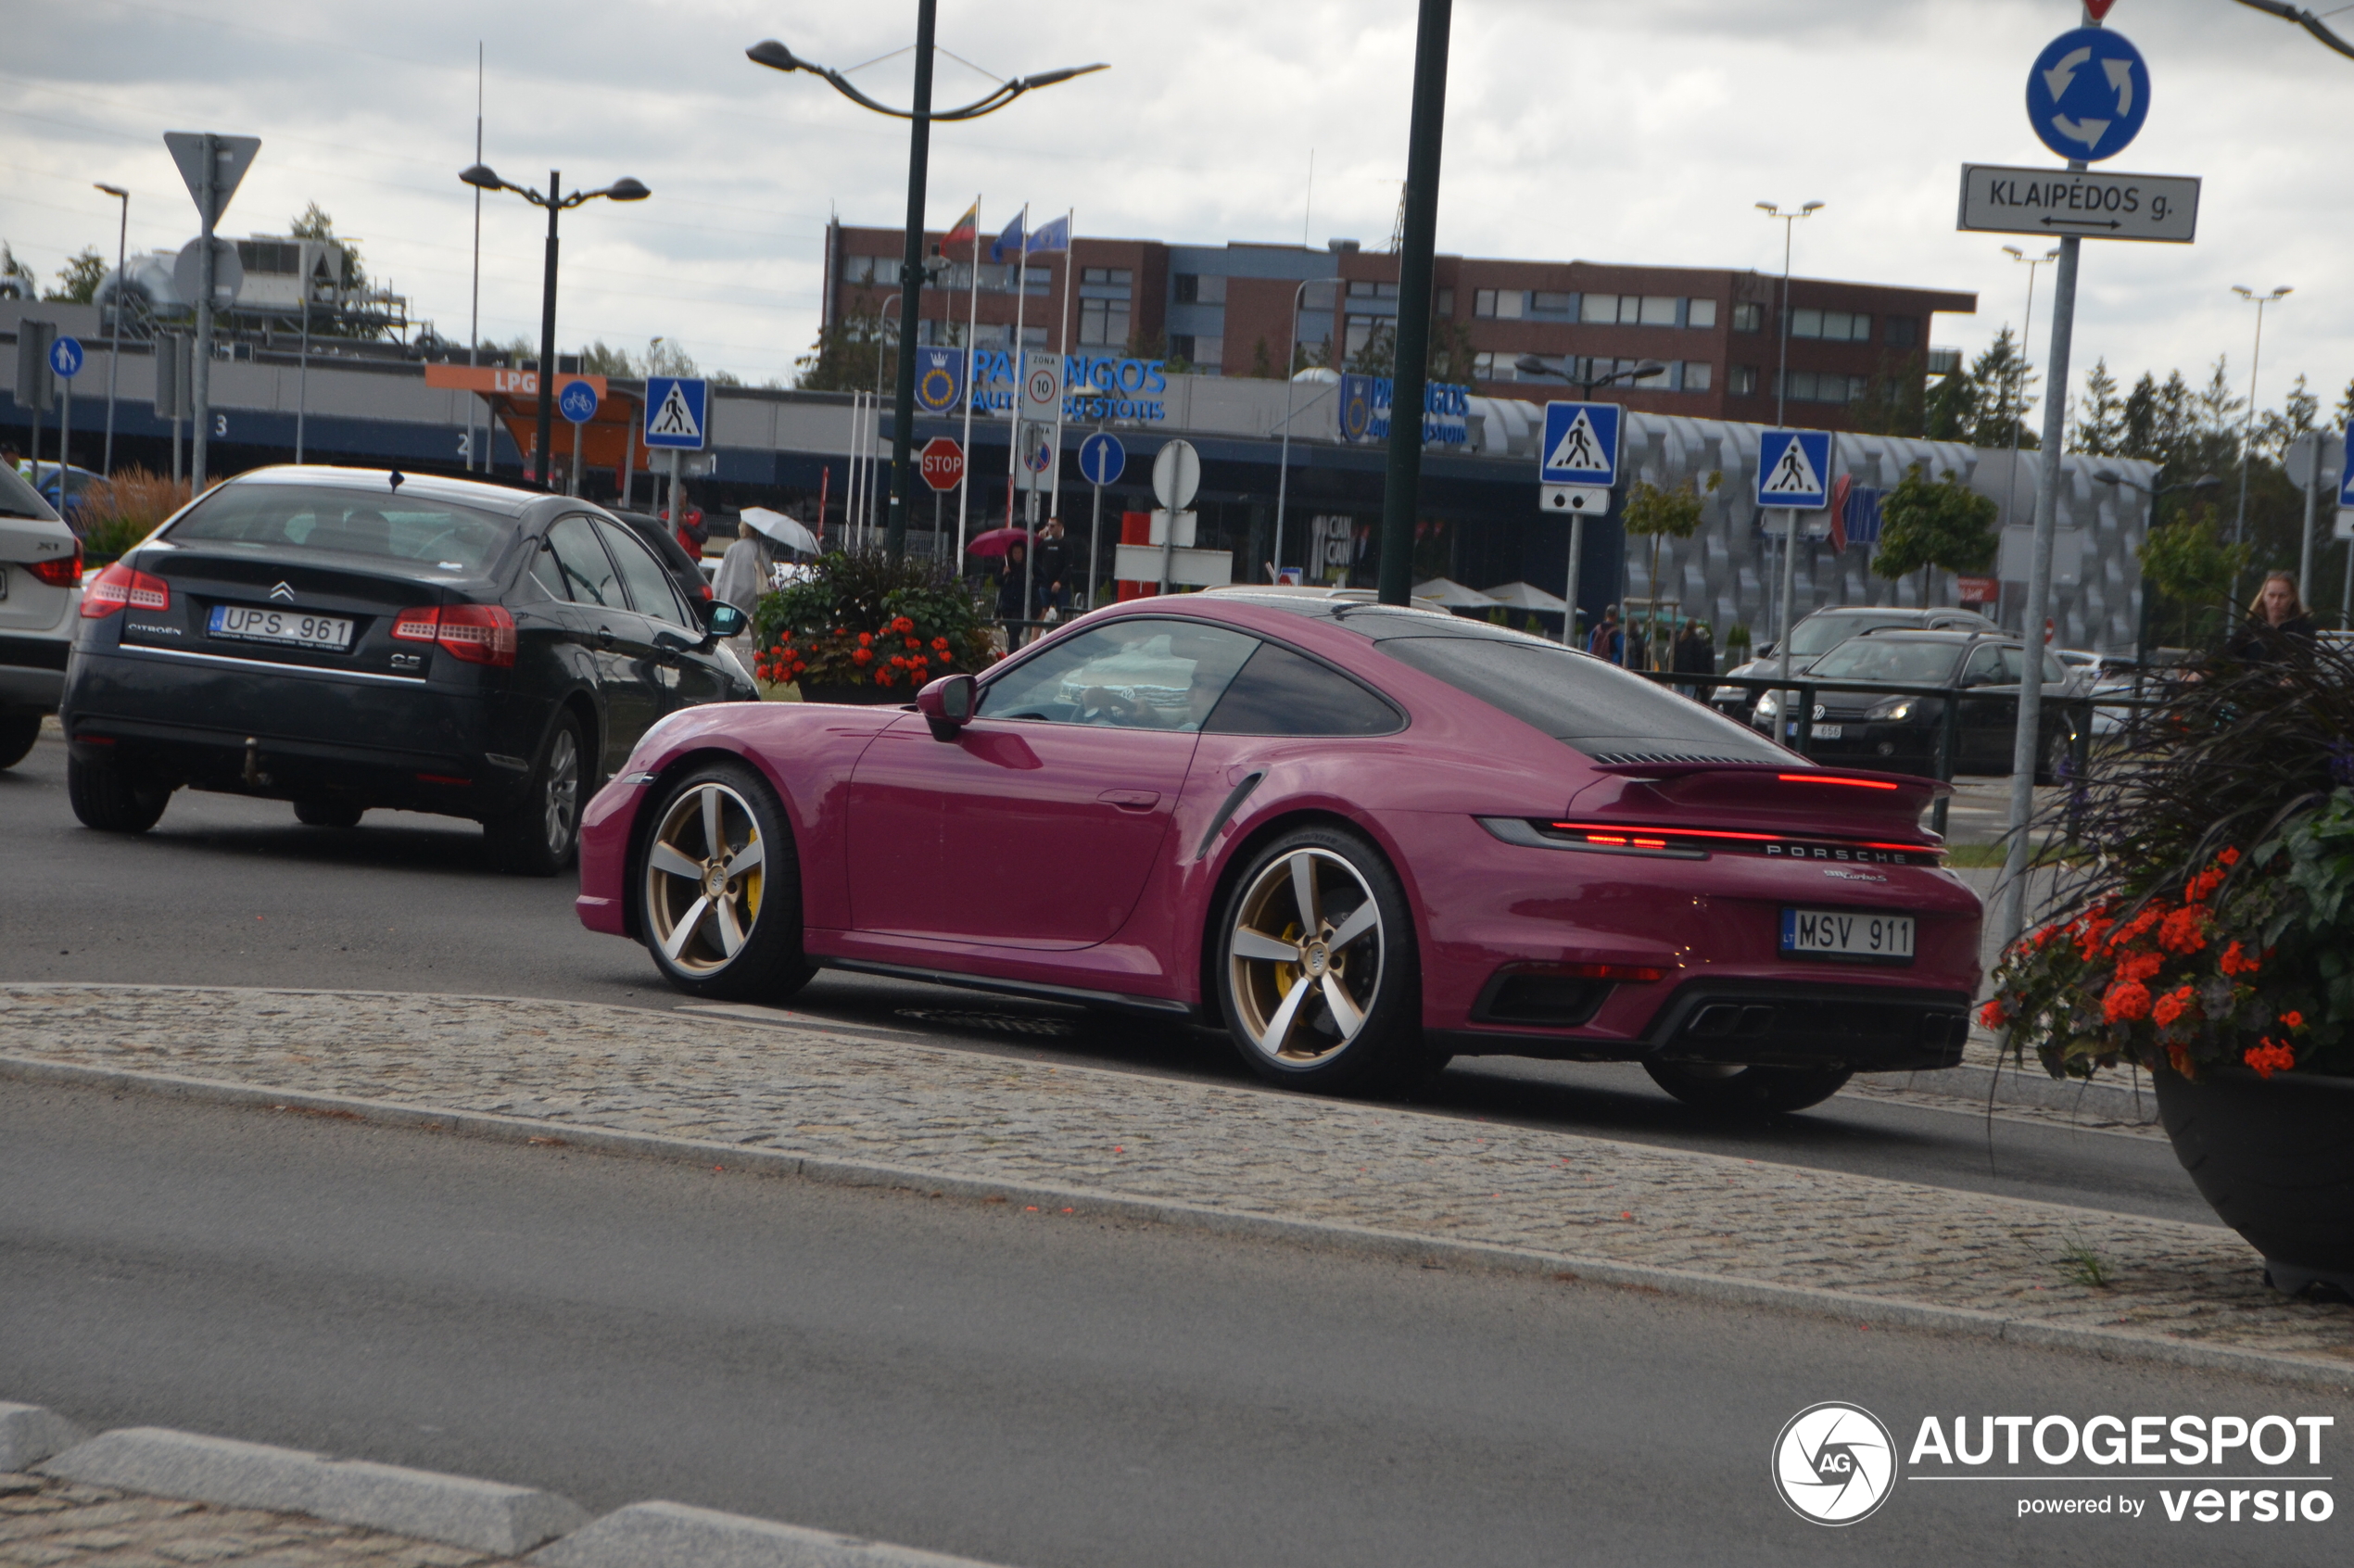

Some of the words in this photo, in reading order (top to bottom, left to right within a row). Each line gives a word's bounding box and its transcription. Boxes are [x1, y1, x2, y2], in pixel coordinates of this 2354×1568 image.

[1990, 177, 2139, 213] KLAIPĖDOS
[2150, 195, 2173, 221] g.
[1033, 355, 1056, 366] ZONA
[494, 371, 537, 394] LPG
[1036, 379, 1049, 394] 10
[1093, 398, 1166, 421] STOTIS
[215, 414, 227, 436] 3
[457, 433, 468, 456] 2
[710, 453, 716, 474] 1
[924, 455, 962, 474] STOP
[1329, 515, 1352, 539] CAN
[37, 542, 59, 550] X1
[1327, 540, 1350, 564] CAN
[226, 609, 283, 634] UPS
[299, 617, 347, 642] 961
[390, 653, 421, 664] C5
[1820, 726, 1841, 737] 656
[1766, 844, 1906, 865] PORSCHE
[1783, 934, 1794, 943] LT
[1800, 914, 1854, 949] MSV
[1869, 919, 1909, 952] 911
